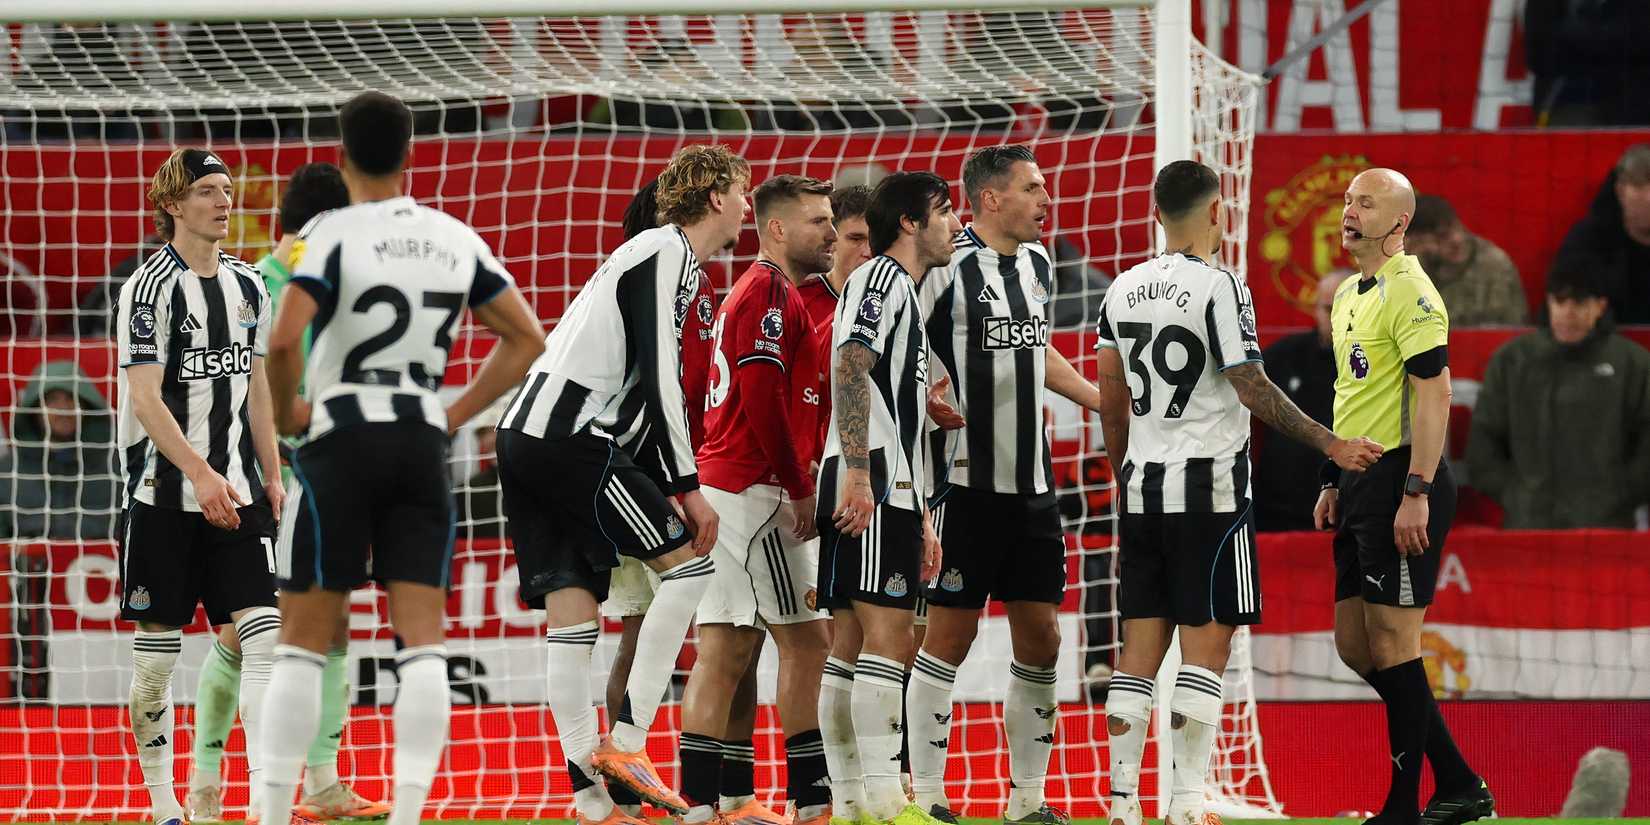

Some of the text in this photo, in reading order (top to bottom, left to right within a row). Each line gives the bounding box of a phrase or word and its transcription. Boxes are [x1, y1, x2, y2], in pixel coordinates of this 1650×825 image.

[373, 237, 460, 273] MURPHY
[1126, 281, 1191, 313] BRUNO G.
[341, 285, 465, 392] 23
[203, 341, 254, 379] sela
[1117, 321, 1207, 418] 39
